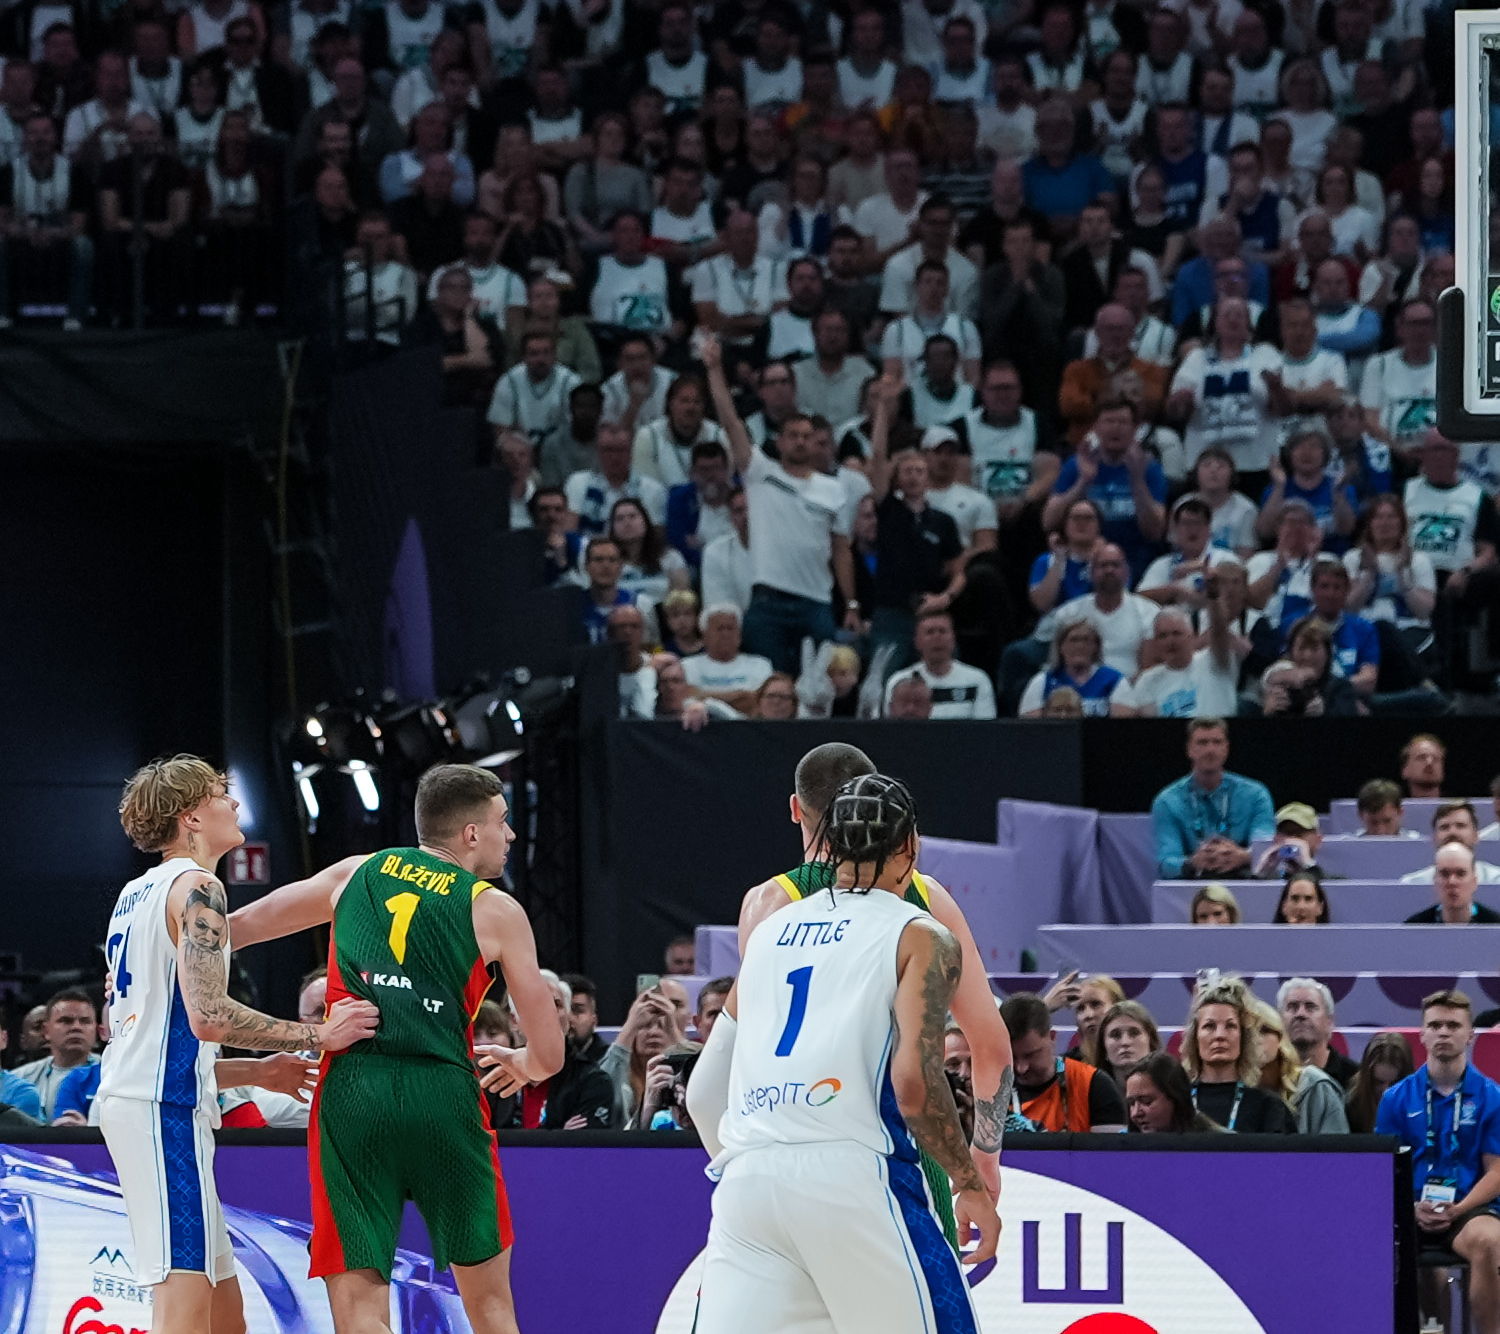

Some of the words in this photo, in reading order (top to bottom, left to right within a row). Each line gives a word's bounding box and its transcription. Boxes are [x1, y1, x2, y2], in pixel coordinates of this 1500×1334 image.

[380, 854, 457, 896] BLAŽEVIČ
[385, 892, 421, 965] 1
[777, 919, 851, 948] LITTLE
[774, 965, 814, 1057] 1
